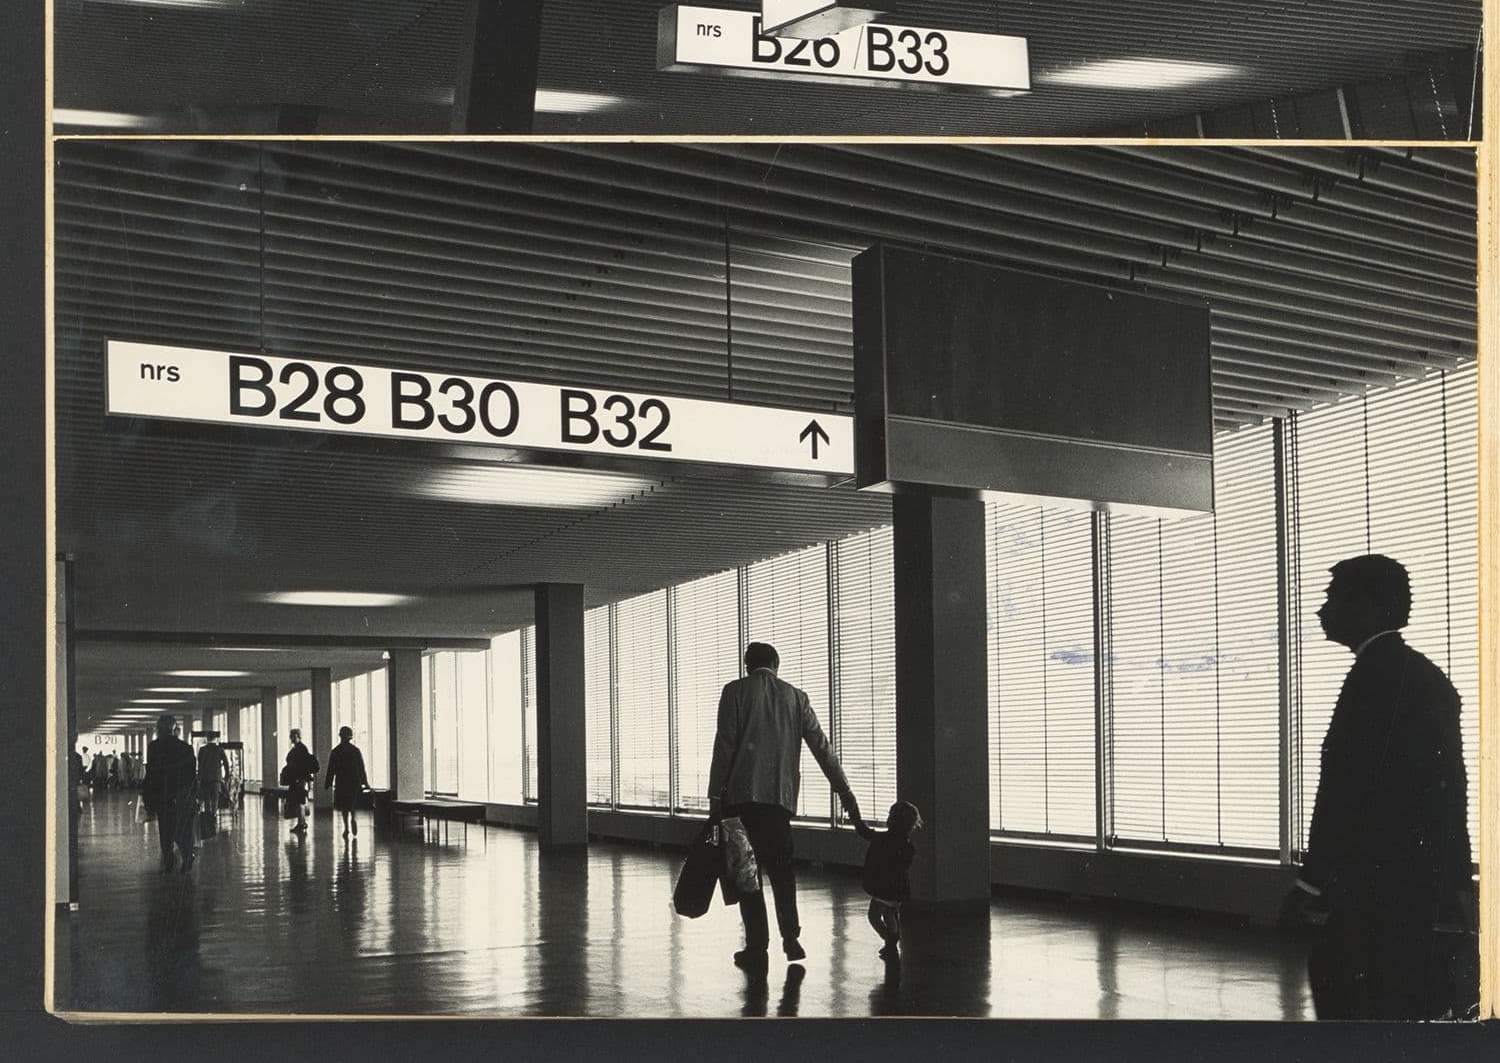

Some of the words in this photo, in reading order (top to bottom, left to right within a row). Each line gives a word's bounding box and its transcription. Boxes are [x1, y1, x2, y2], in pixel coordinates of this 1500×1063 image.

[696, 22, 723, 39] nrs
[866, 26, 950, 77] B33
[139, 362, 182, 384] nrs
[228, 355, 366, 425] B28
[391, 371, 520, 438] B30
[560, 388, 673, 453] B32
